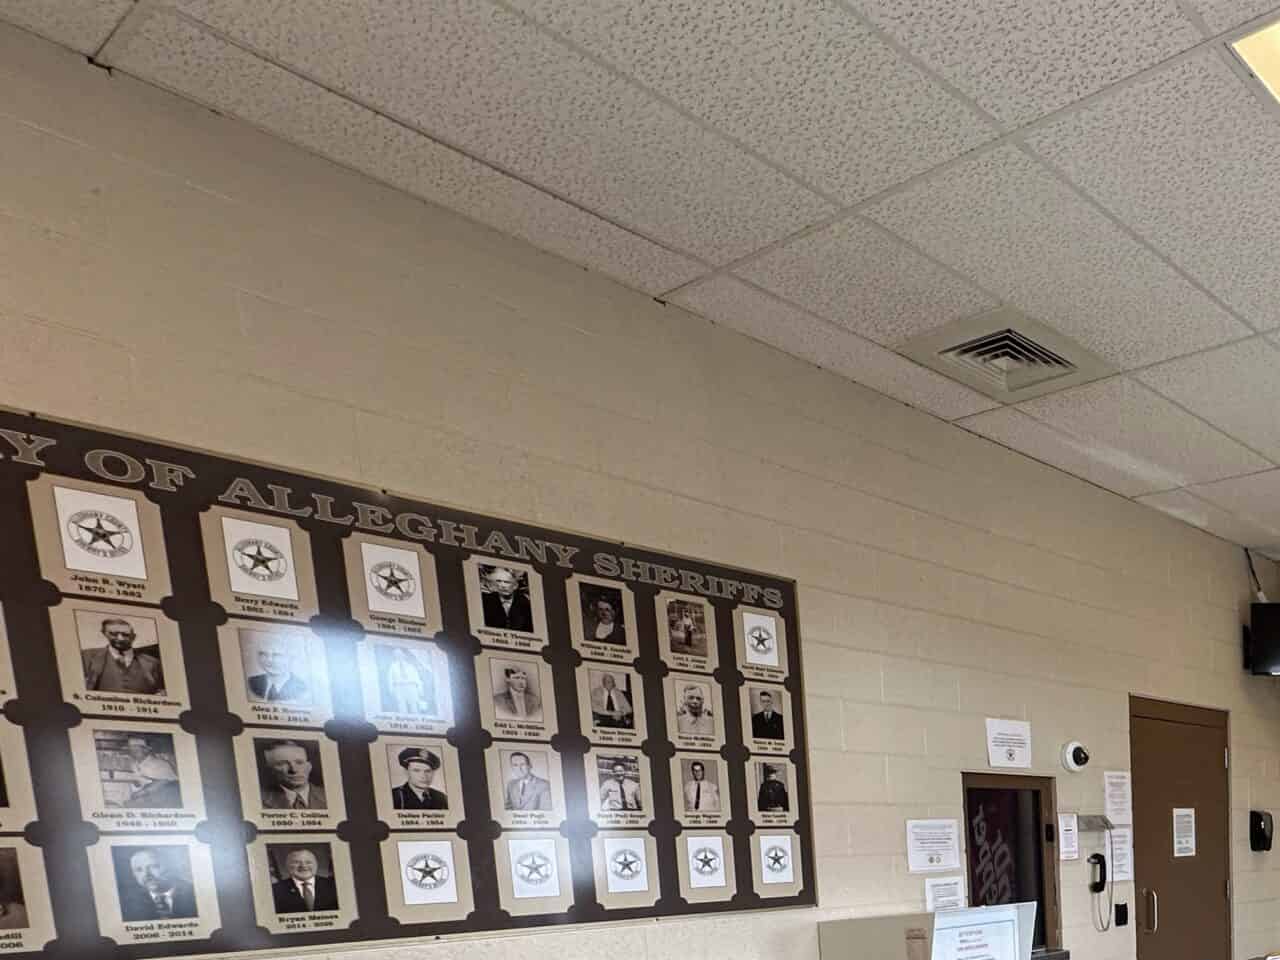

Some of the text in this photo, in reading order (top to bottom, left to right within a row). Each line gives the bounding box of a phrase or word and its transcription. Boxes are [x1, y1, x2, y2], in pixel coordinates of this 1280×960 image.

[0, 428, 57, 467] Y
[84, 449, 197, 492] OF
[218, 477, 580, 568] ALLEGHANY
[593, 552, 785, 609] SHERIFFS
